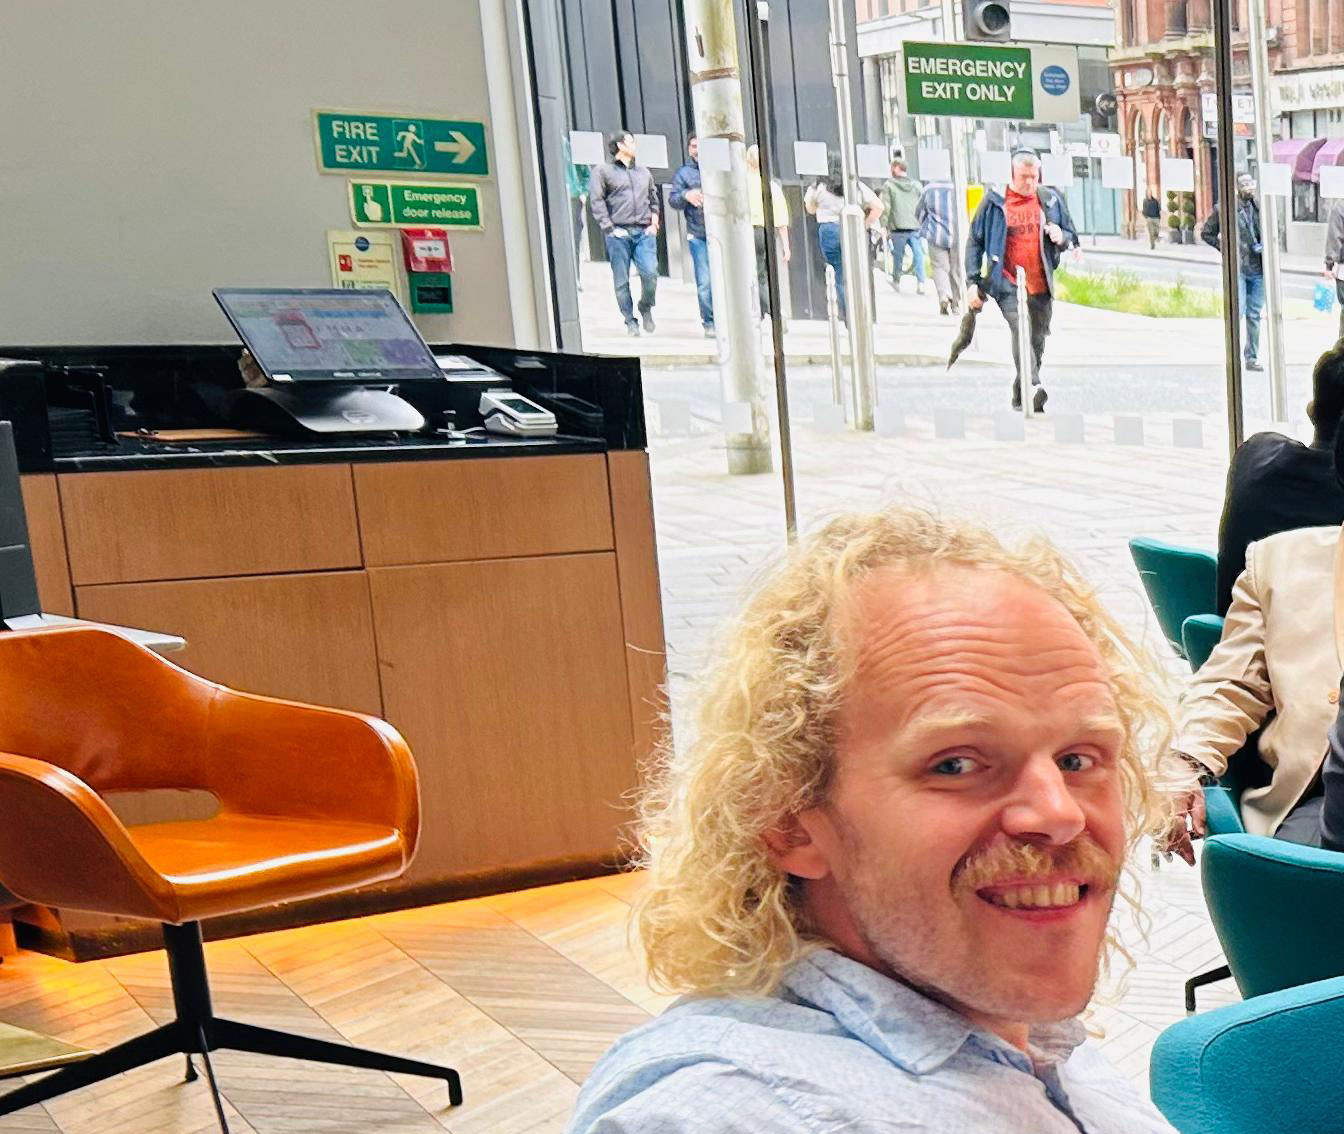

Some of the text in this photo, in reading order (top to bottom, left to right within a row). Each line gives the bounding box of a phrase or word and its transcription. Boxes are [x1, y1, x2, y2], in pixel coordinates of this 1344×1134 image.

[908, 57, 1026, 79] EMERGENCY
[921, 81, 1016, 102] EXIT ONLY
[331, 120, 380, 141] FIRE
[335, 145, 380, 164] EXIT
[403, 189, 467, 205] Emergency
[402, 207, 472, 220] door release
